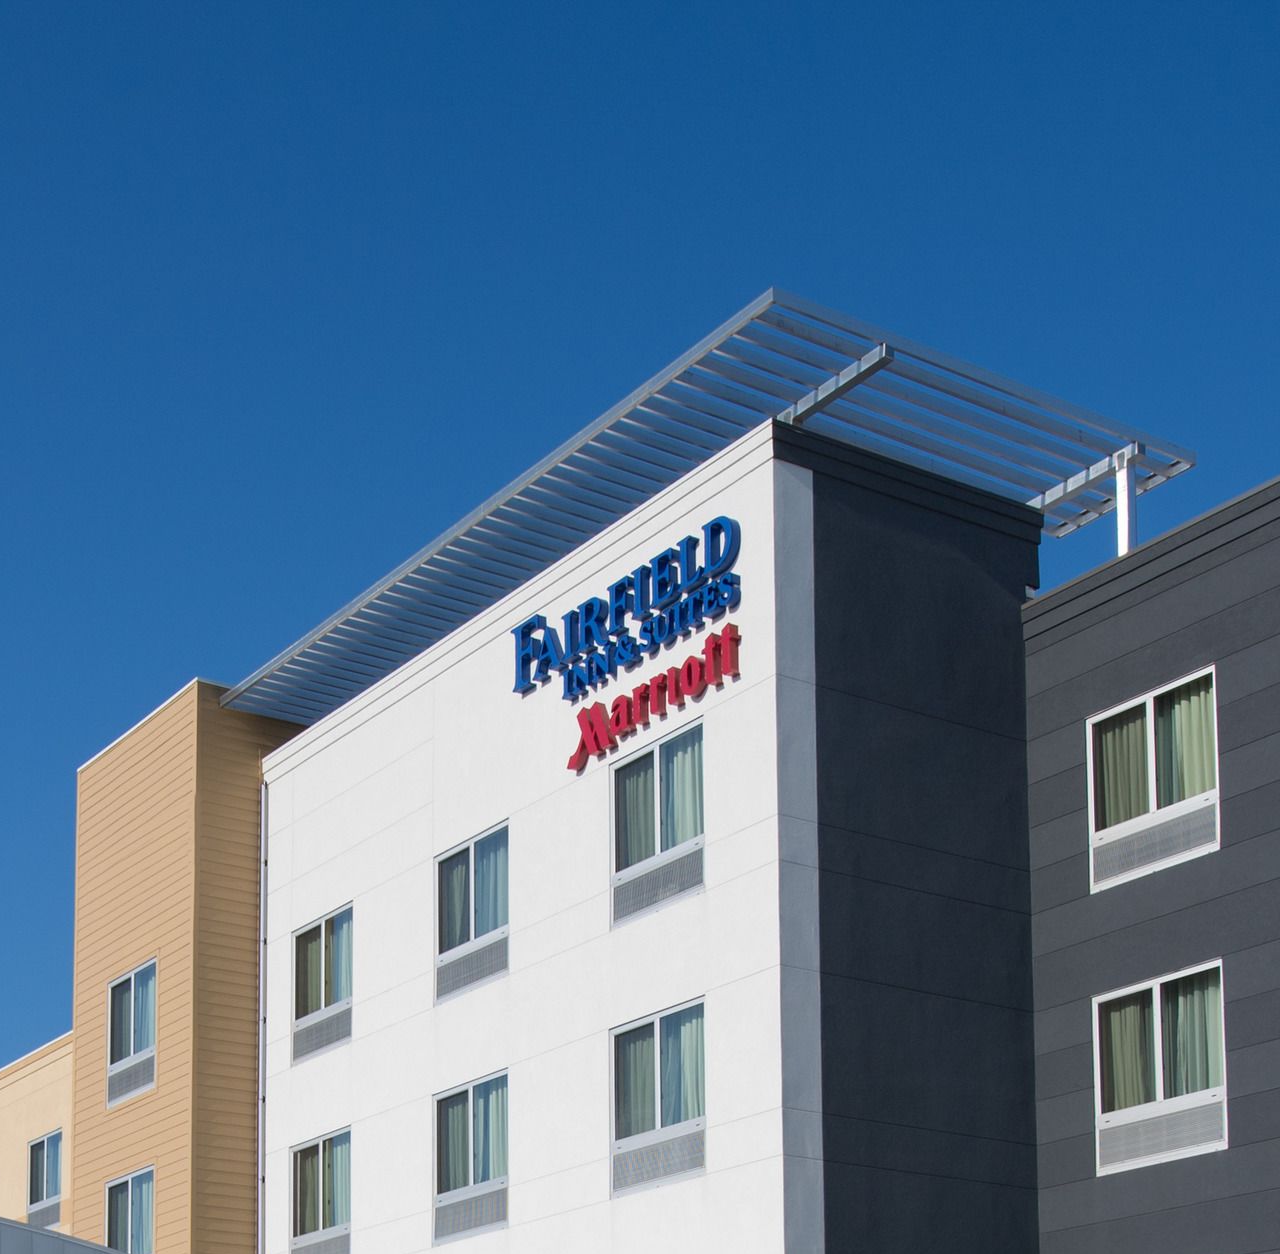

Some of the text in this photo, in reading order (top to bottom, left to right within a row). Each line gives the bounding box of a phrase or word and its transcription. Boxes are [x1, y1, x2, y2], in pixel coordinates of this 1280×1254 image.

[511, 515, 741, 697] FAIRFIELD
[562, 640, 617, 702] INN
[638, 571, 741, 656] SUITES
[566, 622, 741, 774] Marriott
